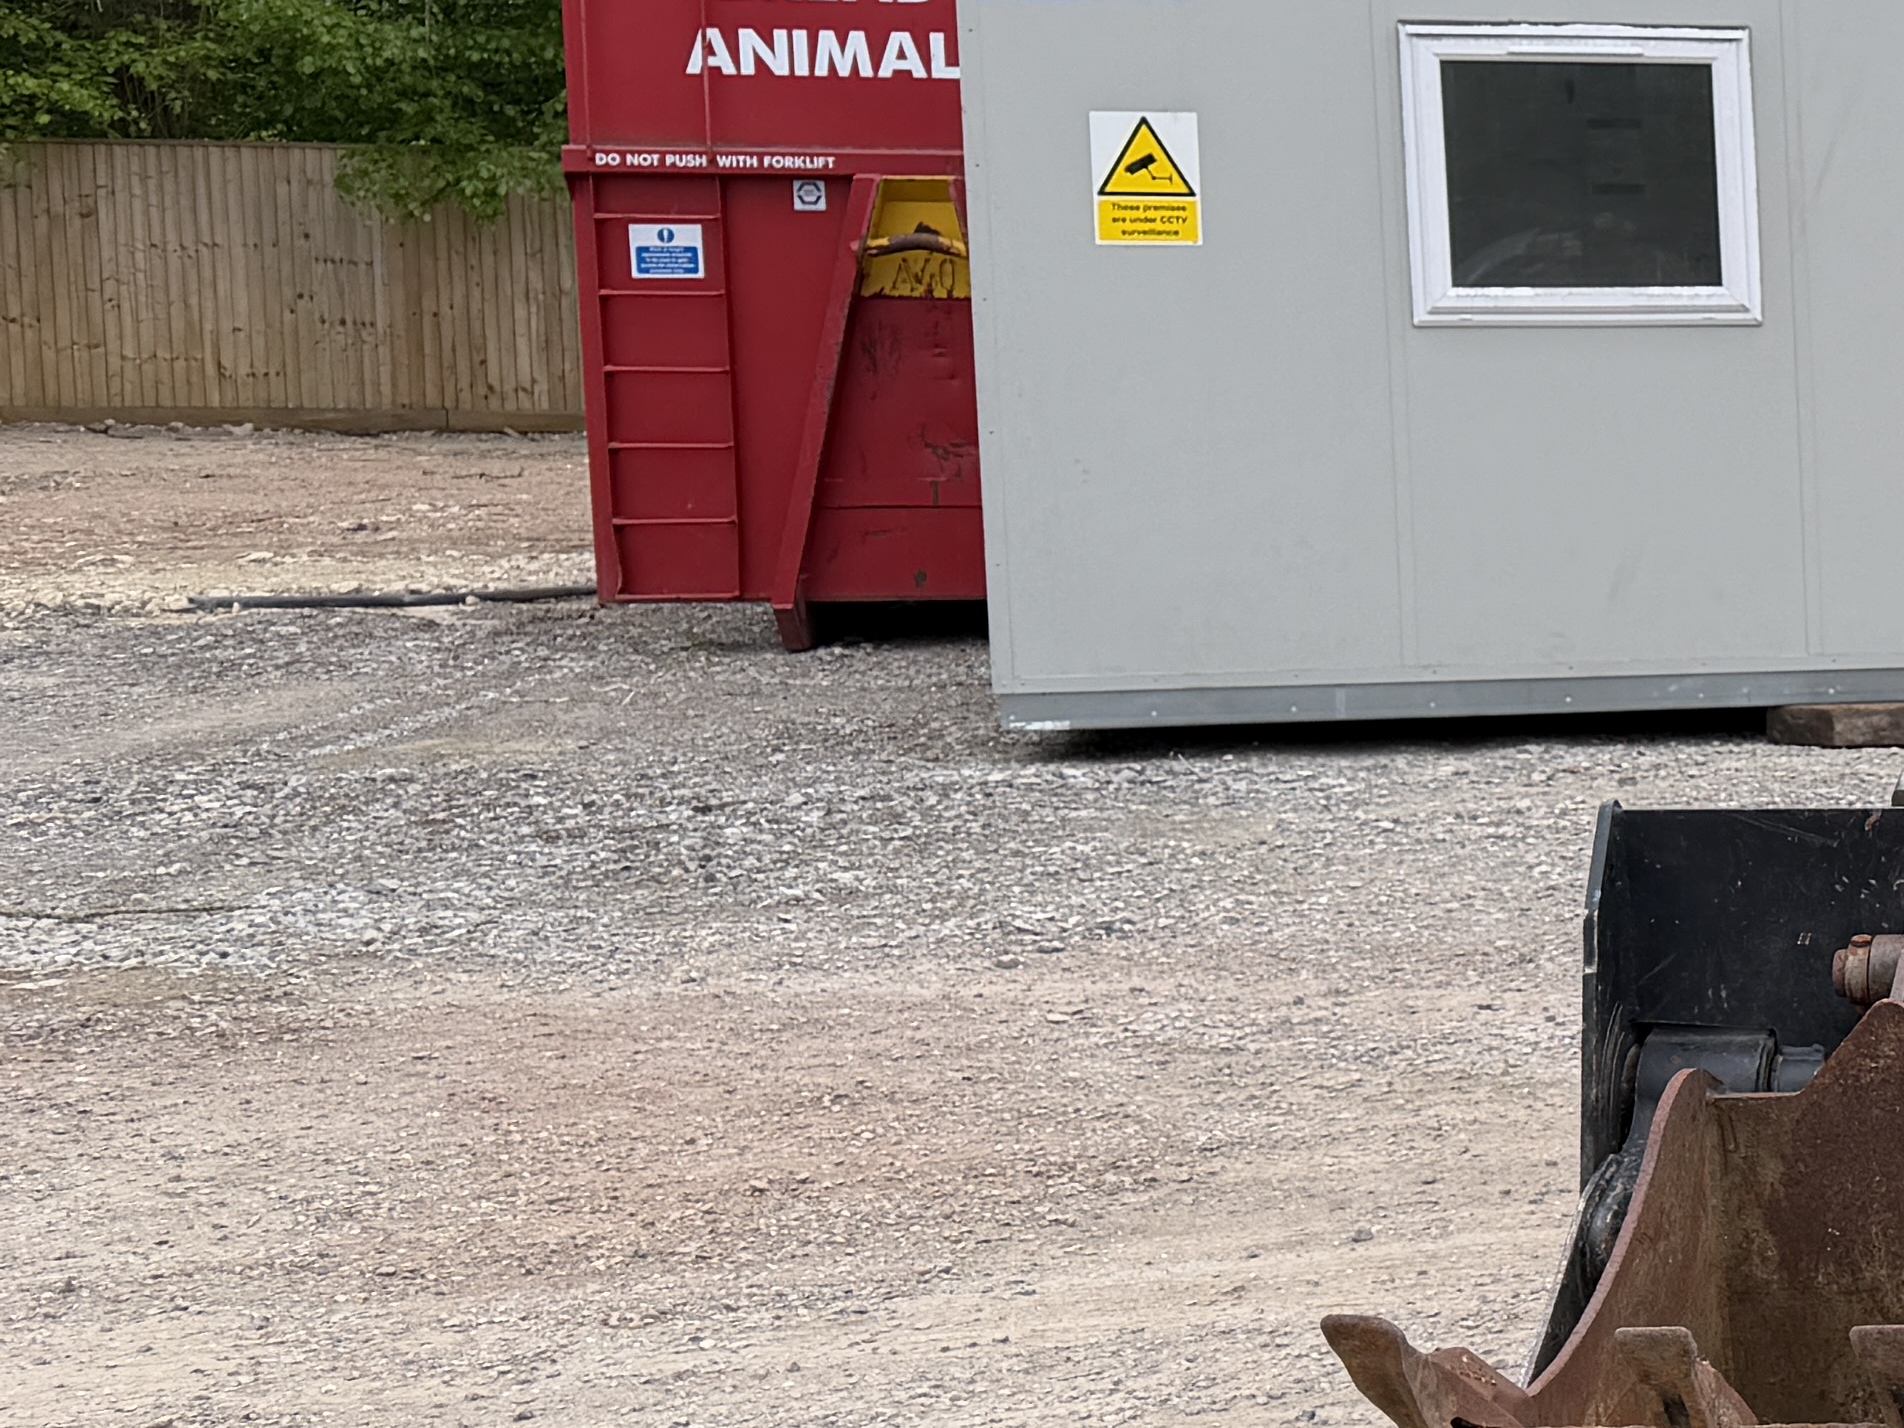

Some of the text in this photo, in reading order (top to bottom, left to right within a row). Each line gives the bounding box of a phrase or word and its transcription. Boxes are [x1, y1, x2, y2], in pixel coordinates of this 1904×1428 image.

[685, 27, 961, 80] ANIMAL
[594, 153, 837, 169] DO NOT PUSH WITH FORKLIFT
[1111, 202, 1187, 213] These premises
[1129, 216, 1157, 224] under
[1159, 215, 1188, 224] CCTV
